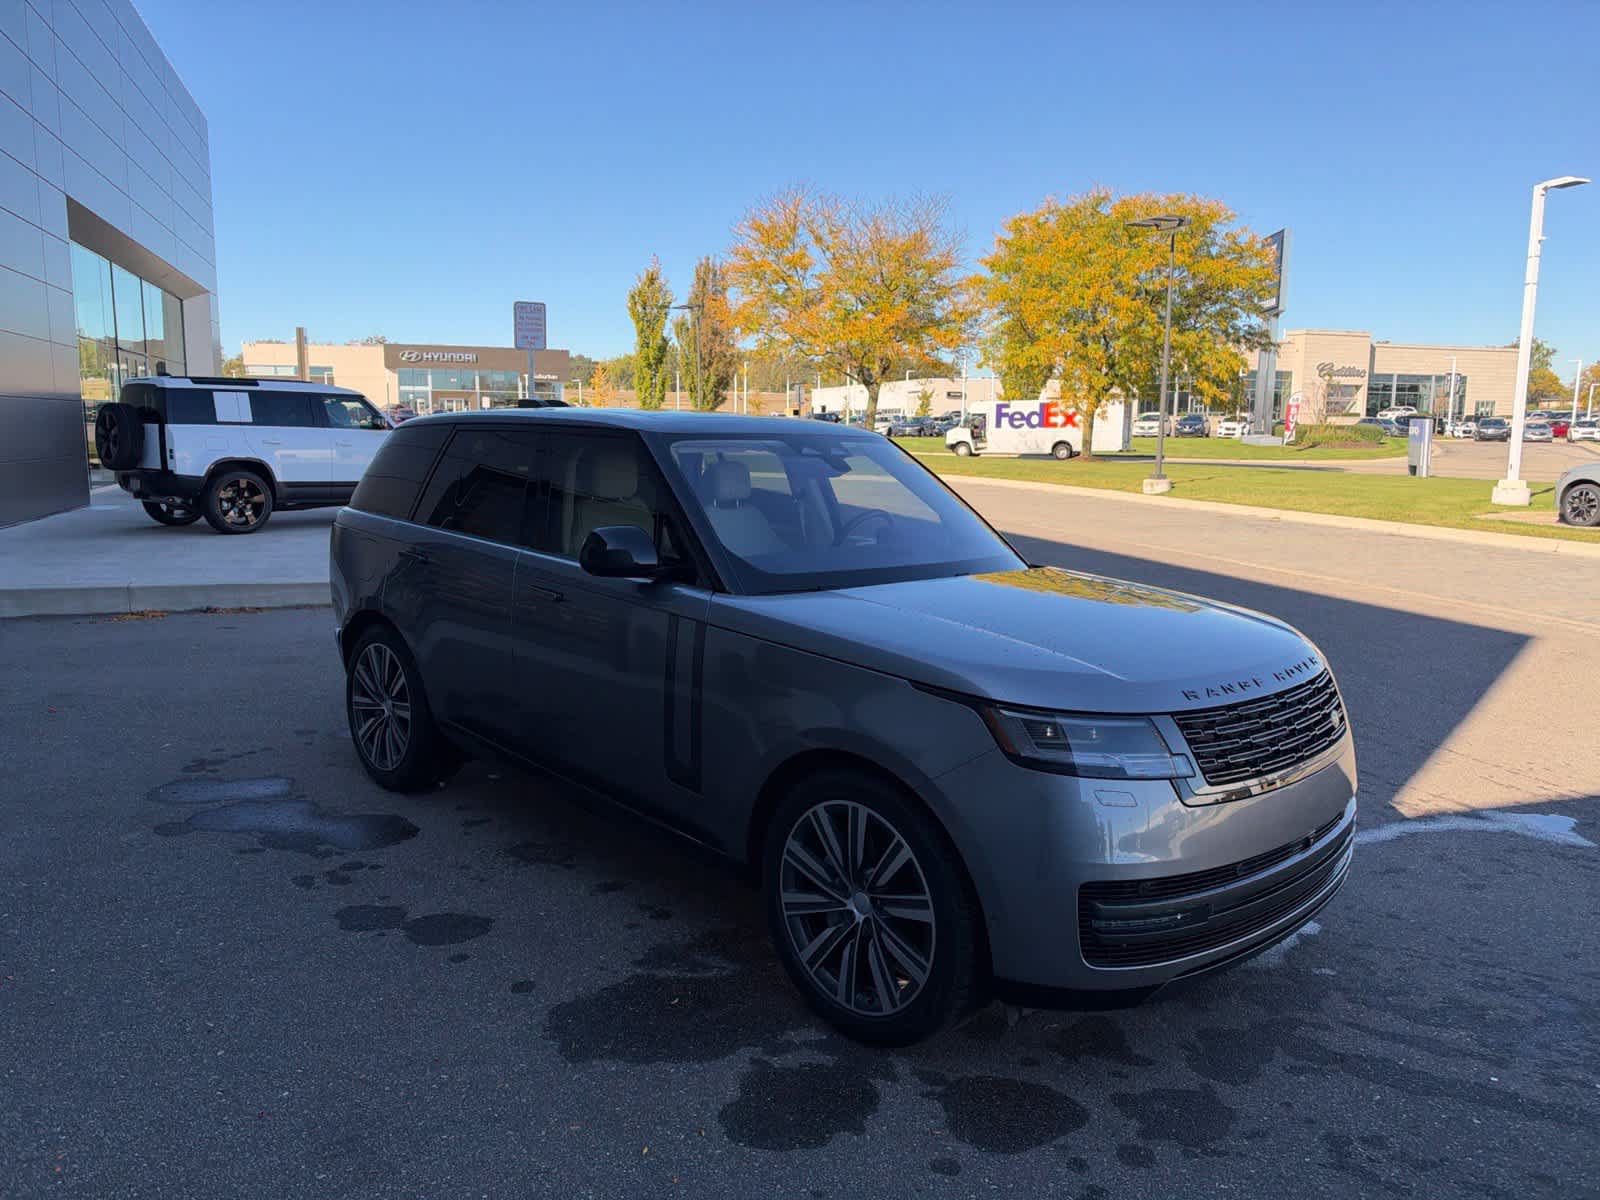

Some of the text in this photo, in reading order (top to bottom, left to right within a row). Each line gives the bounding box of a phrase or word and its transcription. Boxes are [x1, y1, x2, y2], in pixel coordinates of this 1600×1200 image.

[422, 352, 479, 363] HYUNDAI
[1316, 362, 1367, 381] Cadillac
[995, 402, 1078, 429] FedEx
